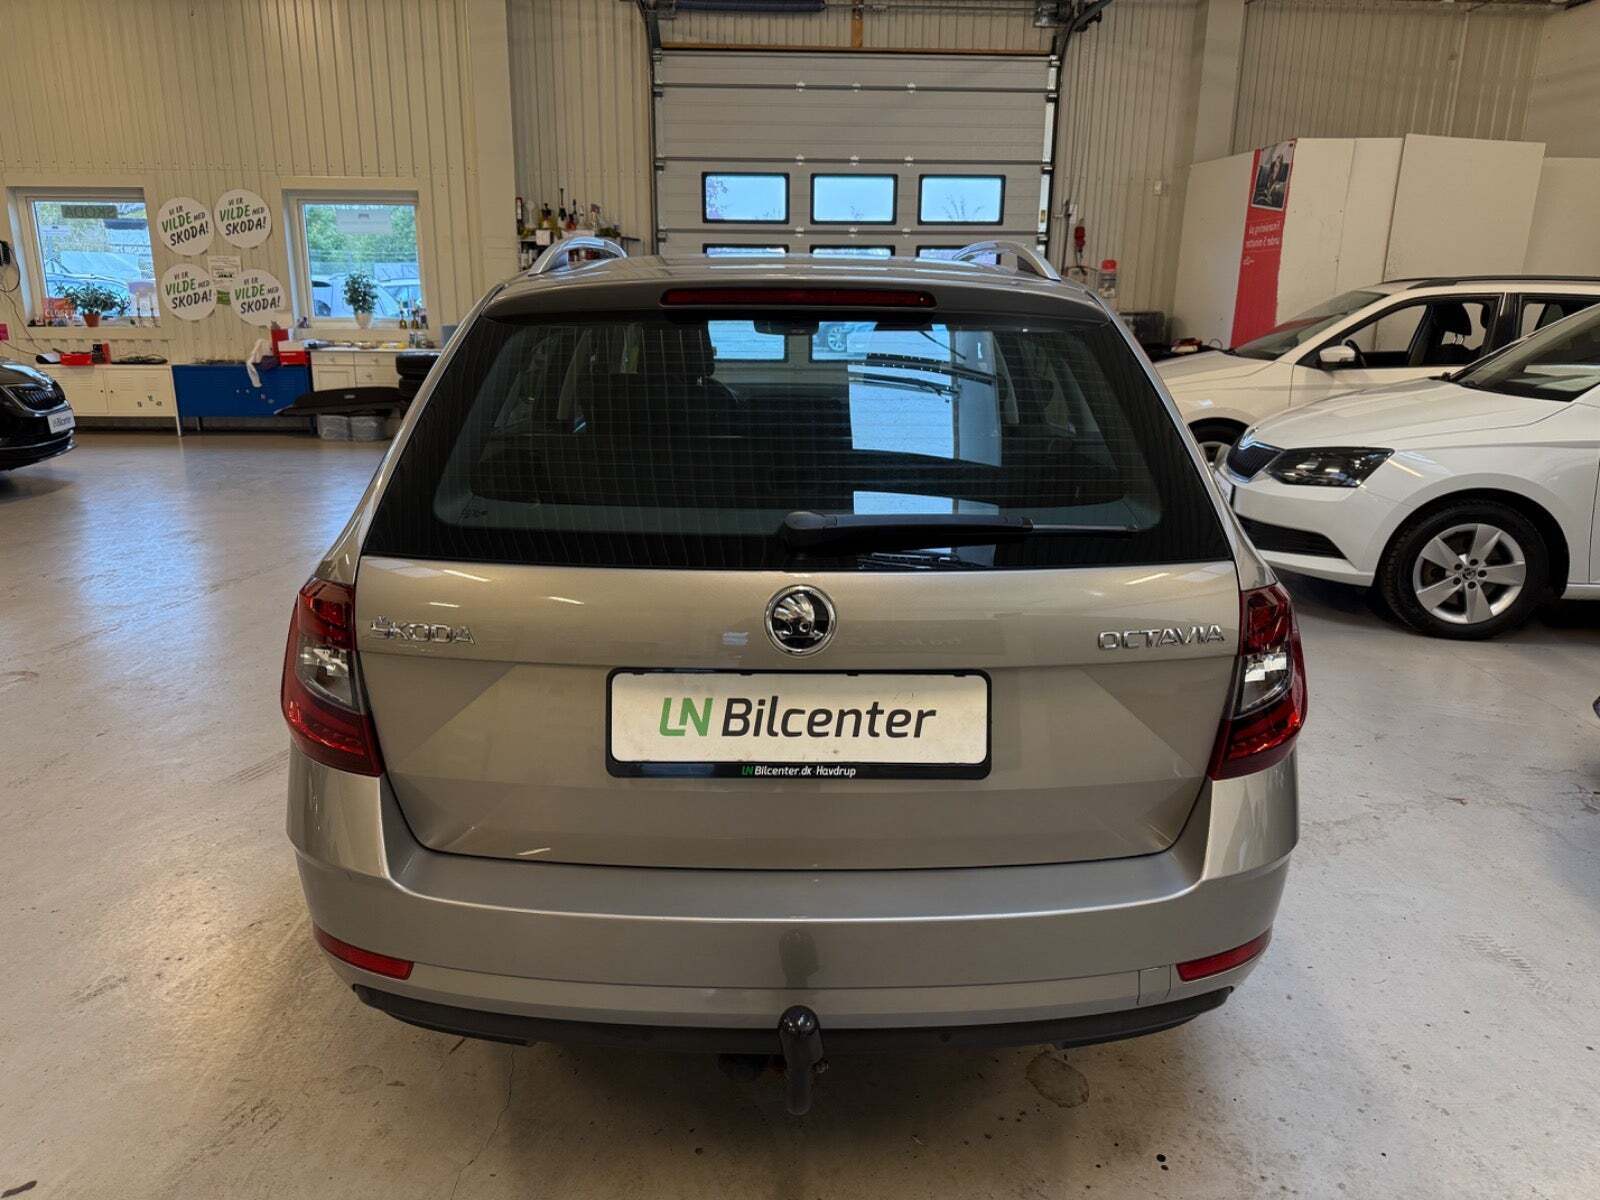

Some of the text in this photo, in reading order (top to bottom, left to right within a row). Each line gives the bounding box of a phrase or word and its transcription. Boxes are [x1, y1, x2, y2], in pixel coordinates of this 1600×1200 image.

[162, 211, 206, 233] VILDE MED
[220, 204, 250, 222] VILDE
[170, 220, 209, 246] SKODA!
[225, 216, 266, 236] SKODA!
[165, 278, 196, 296] VILDE
[235, 284, 265, 300] VILDE
[172, 289, 212, 309] SKODA!
[240, 295, 281, 314] SKODA!
[1098, 624, 1224, 650] OCTAVIA
[659, 696, 937, 738] LN Bilcenter
[754, 765, 812, 776] Bilcenter.dk
[816, 765, 857, 778] Havdrup
